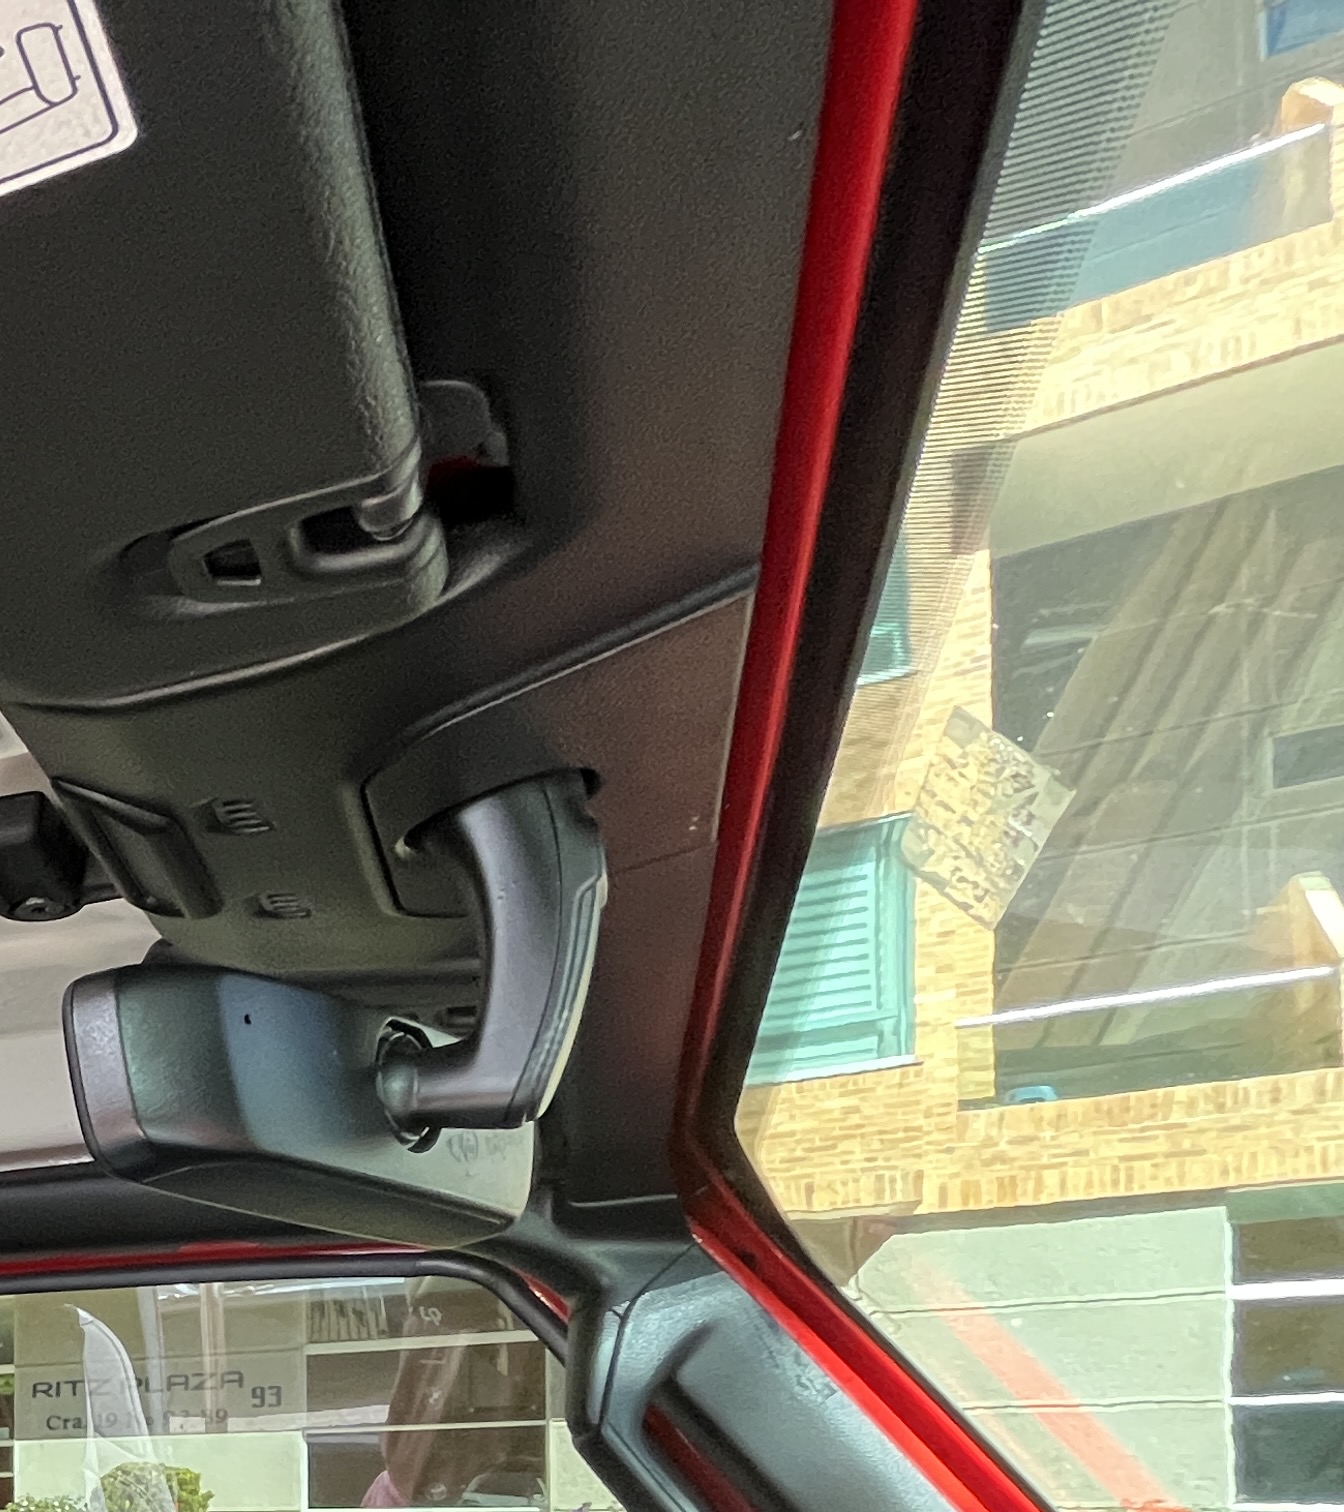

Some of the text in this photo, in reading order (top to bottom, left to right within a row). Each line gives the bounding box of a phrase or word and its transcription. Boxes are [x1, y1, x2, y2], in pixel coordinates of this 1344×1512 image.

[32, 1369, 283, 1409] RITZ PLAZA 93
